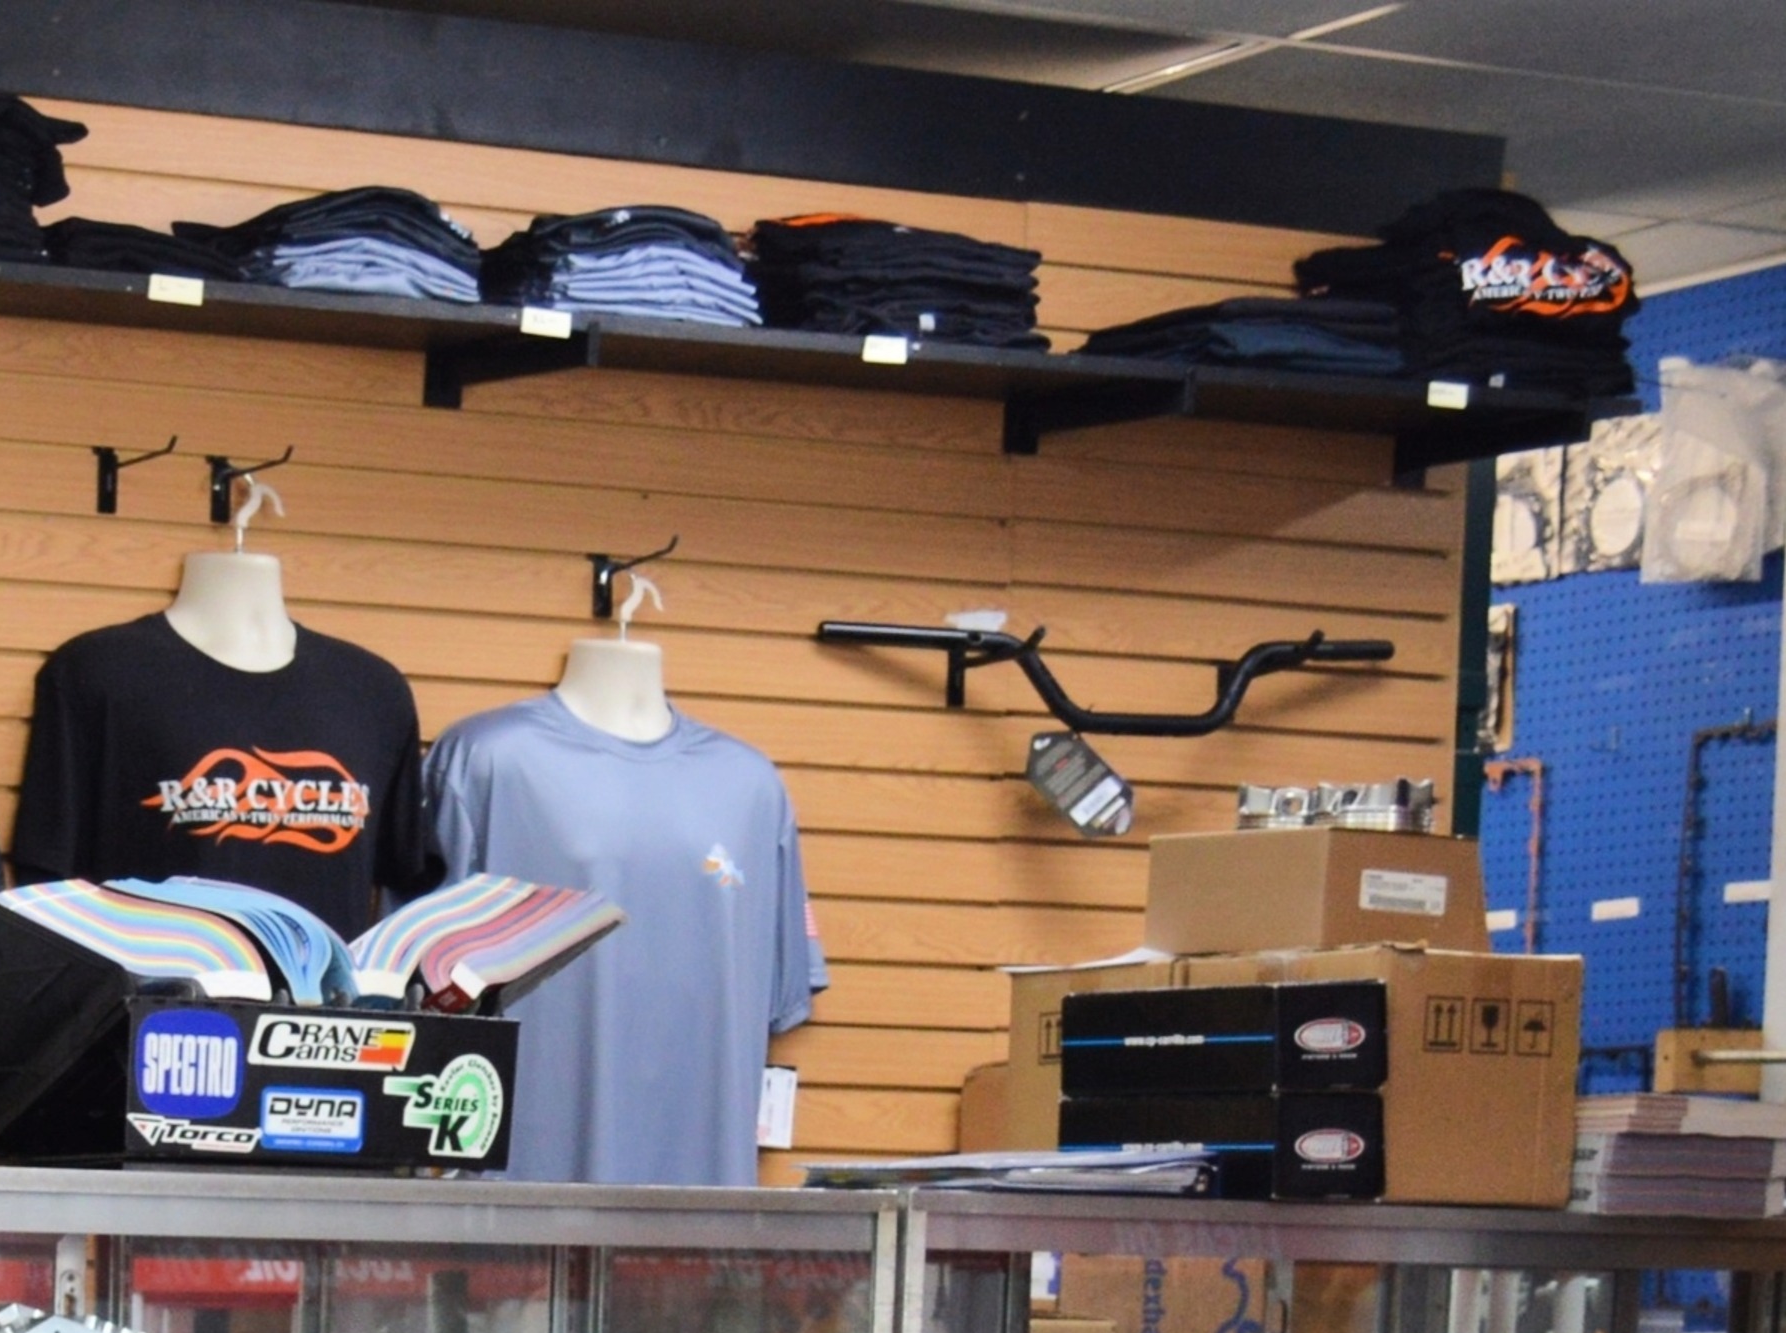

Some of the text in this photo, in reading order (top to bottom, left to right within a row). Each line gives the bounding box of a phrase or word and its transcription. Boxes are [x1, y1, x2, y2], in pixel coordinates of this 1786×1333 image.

[157, 776, 238, 812] R&R
[142, 1032, 238, 1099] SPECTRO
[268, 1097, 358, 1119] DYNA
[433, 1114, 471, 1152] K
